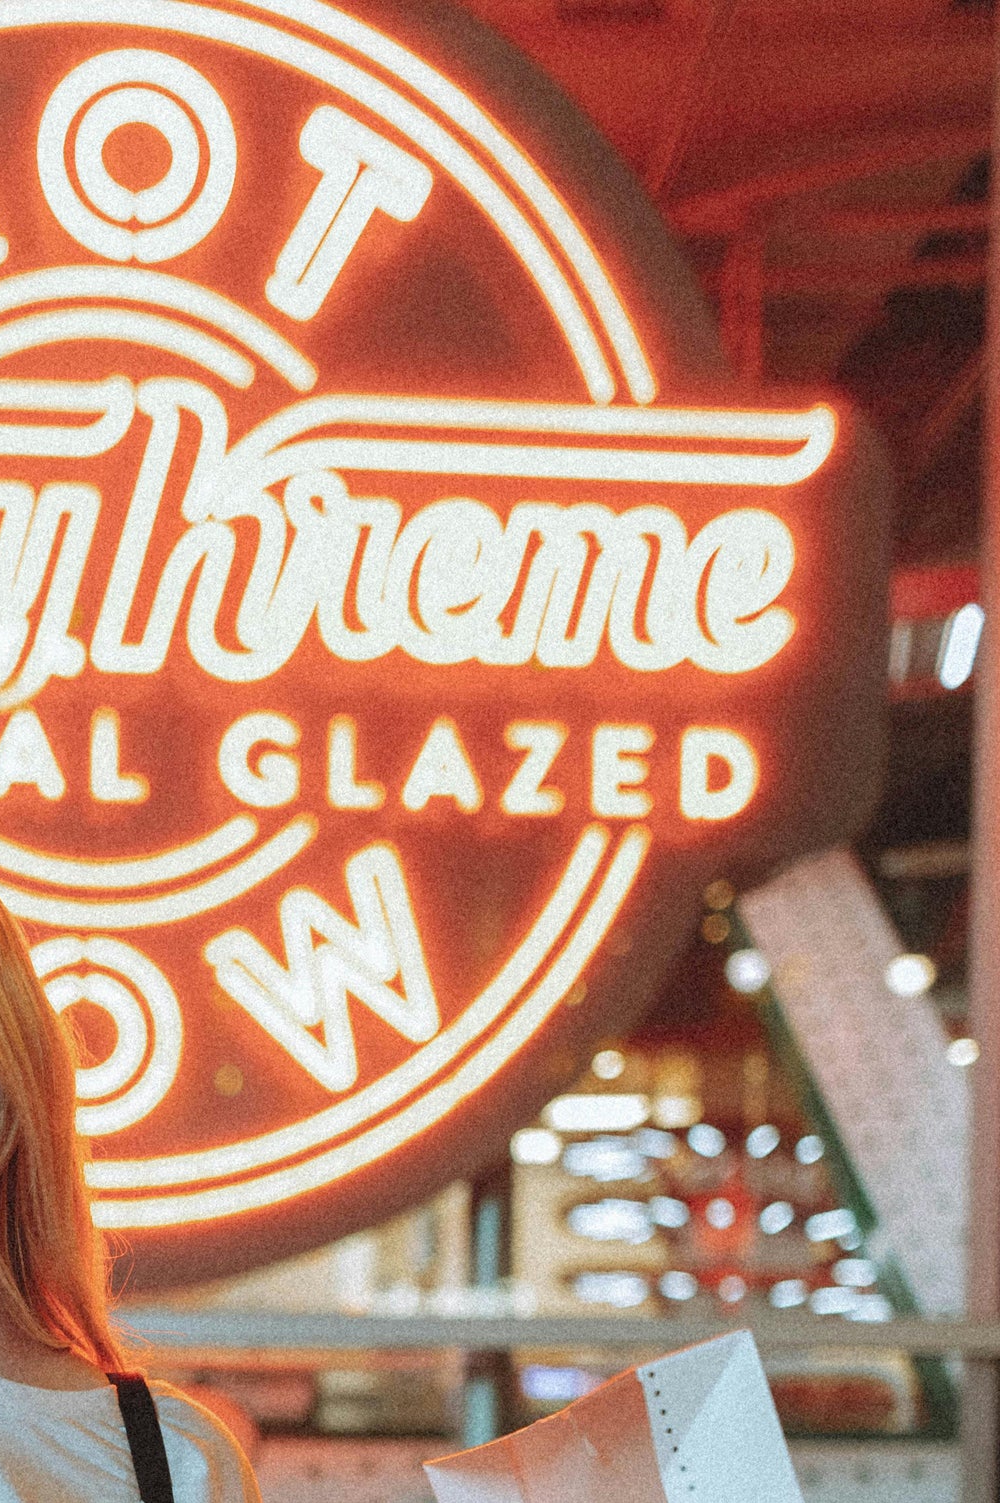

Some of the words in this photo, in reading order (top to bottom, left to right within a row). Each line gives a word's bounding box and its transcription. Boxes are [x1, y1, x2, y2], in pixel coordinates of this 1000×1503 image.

[90, 375, 837, 683] Kreme
[216, 708, 758, 820] GLAZED
[28, 842, 440, 1137] OW
